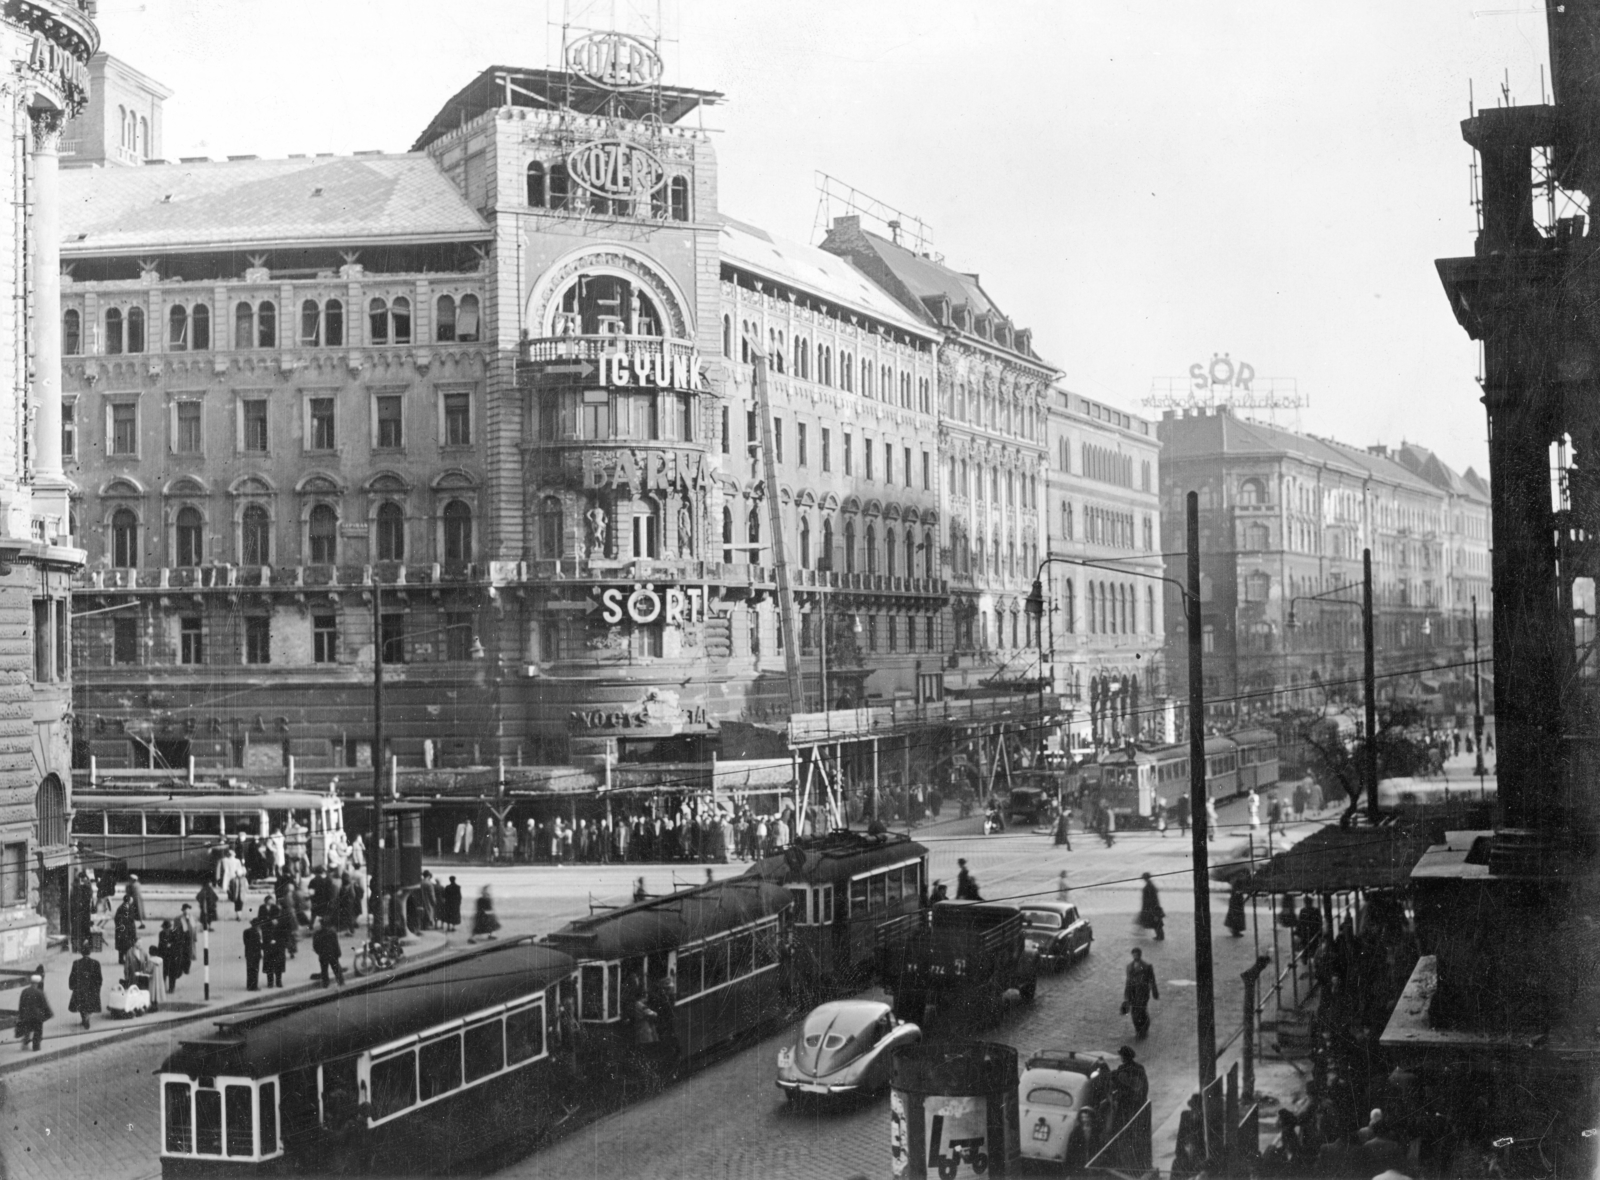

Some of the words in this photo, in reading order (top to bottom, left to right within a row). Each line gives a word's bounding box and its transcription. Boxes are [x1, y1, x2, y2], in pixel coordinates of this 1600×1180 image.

[573, 35, 659, 84] KÖZÉRT
[575, 142, 659, 193] KÖZÉRT
[598, 350, 703, 389] IGYUNK
[1189, 352, 1255, 390] SÖR
[583, 450, 711, 493] BARNA
[602, 583, 709, 624] SÖRT!
